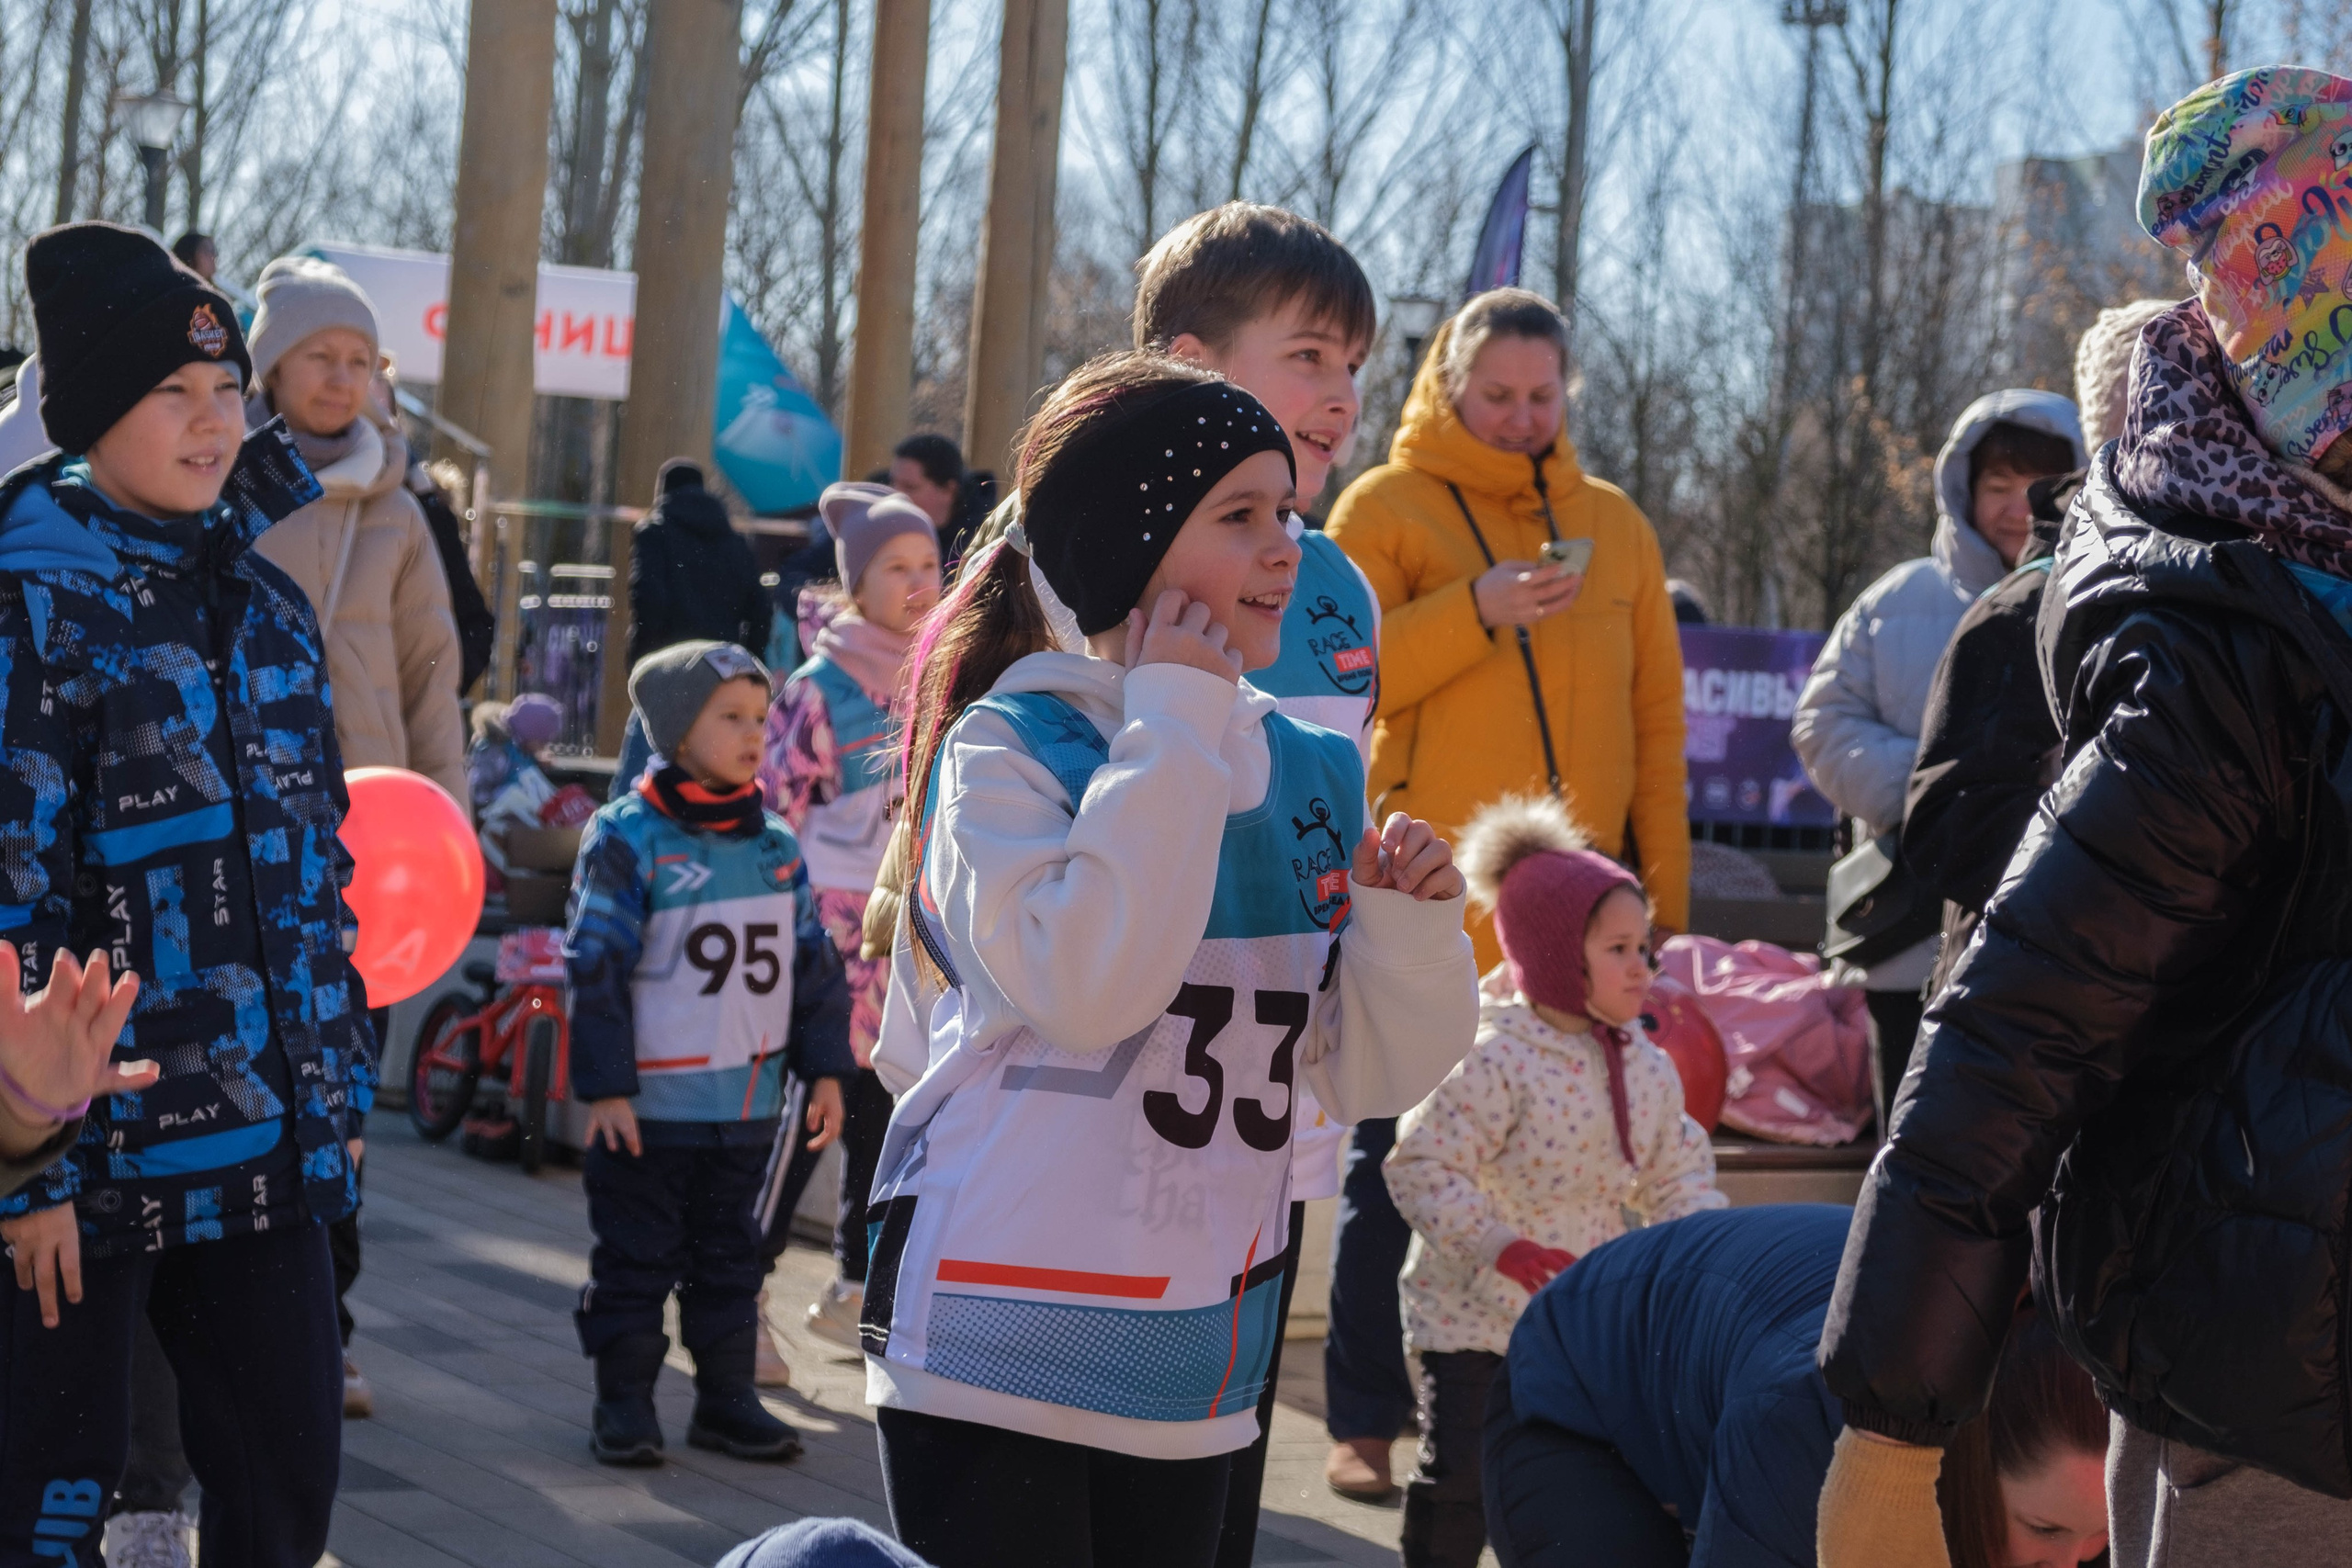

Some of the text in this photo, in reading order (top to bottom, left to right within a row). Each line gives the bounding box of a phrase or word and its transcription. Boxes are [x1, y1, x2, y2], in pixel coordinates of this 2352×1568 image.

[1338, 649, 1371, 669] TIME
[118, 784, 179, 812] PLAY
[212, 857, 231, 928] STAR
[106, 883, 132, 971] PLAY
[22, 940, 39, 996] TAR
[685, 921, 780, 997] 95
[1142, 984, 1310, 1152] 33
[158, 1101, 221, 1131] PLAY
[253, 1173, 270, 1232] SAR
